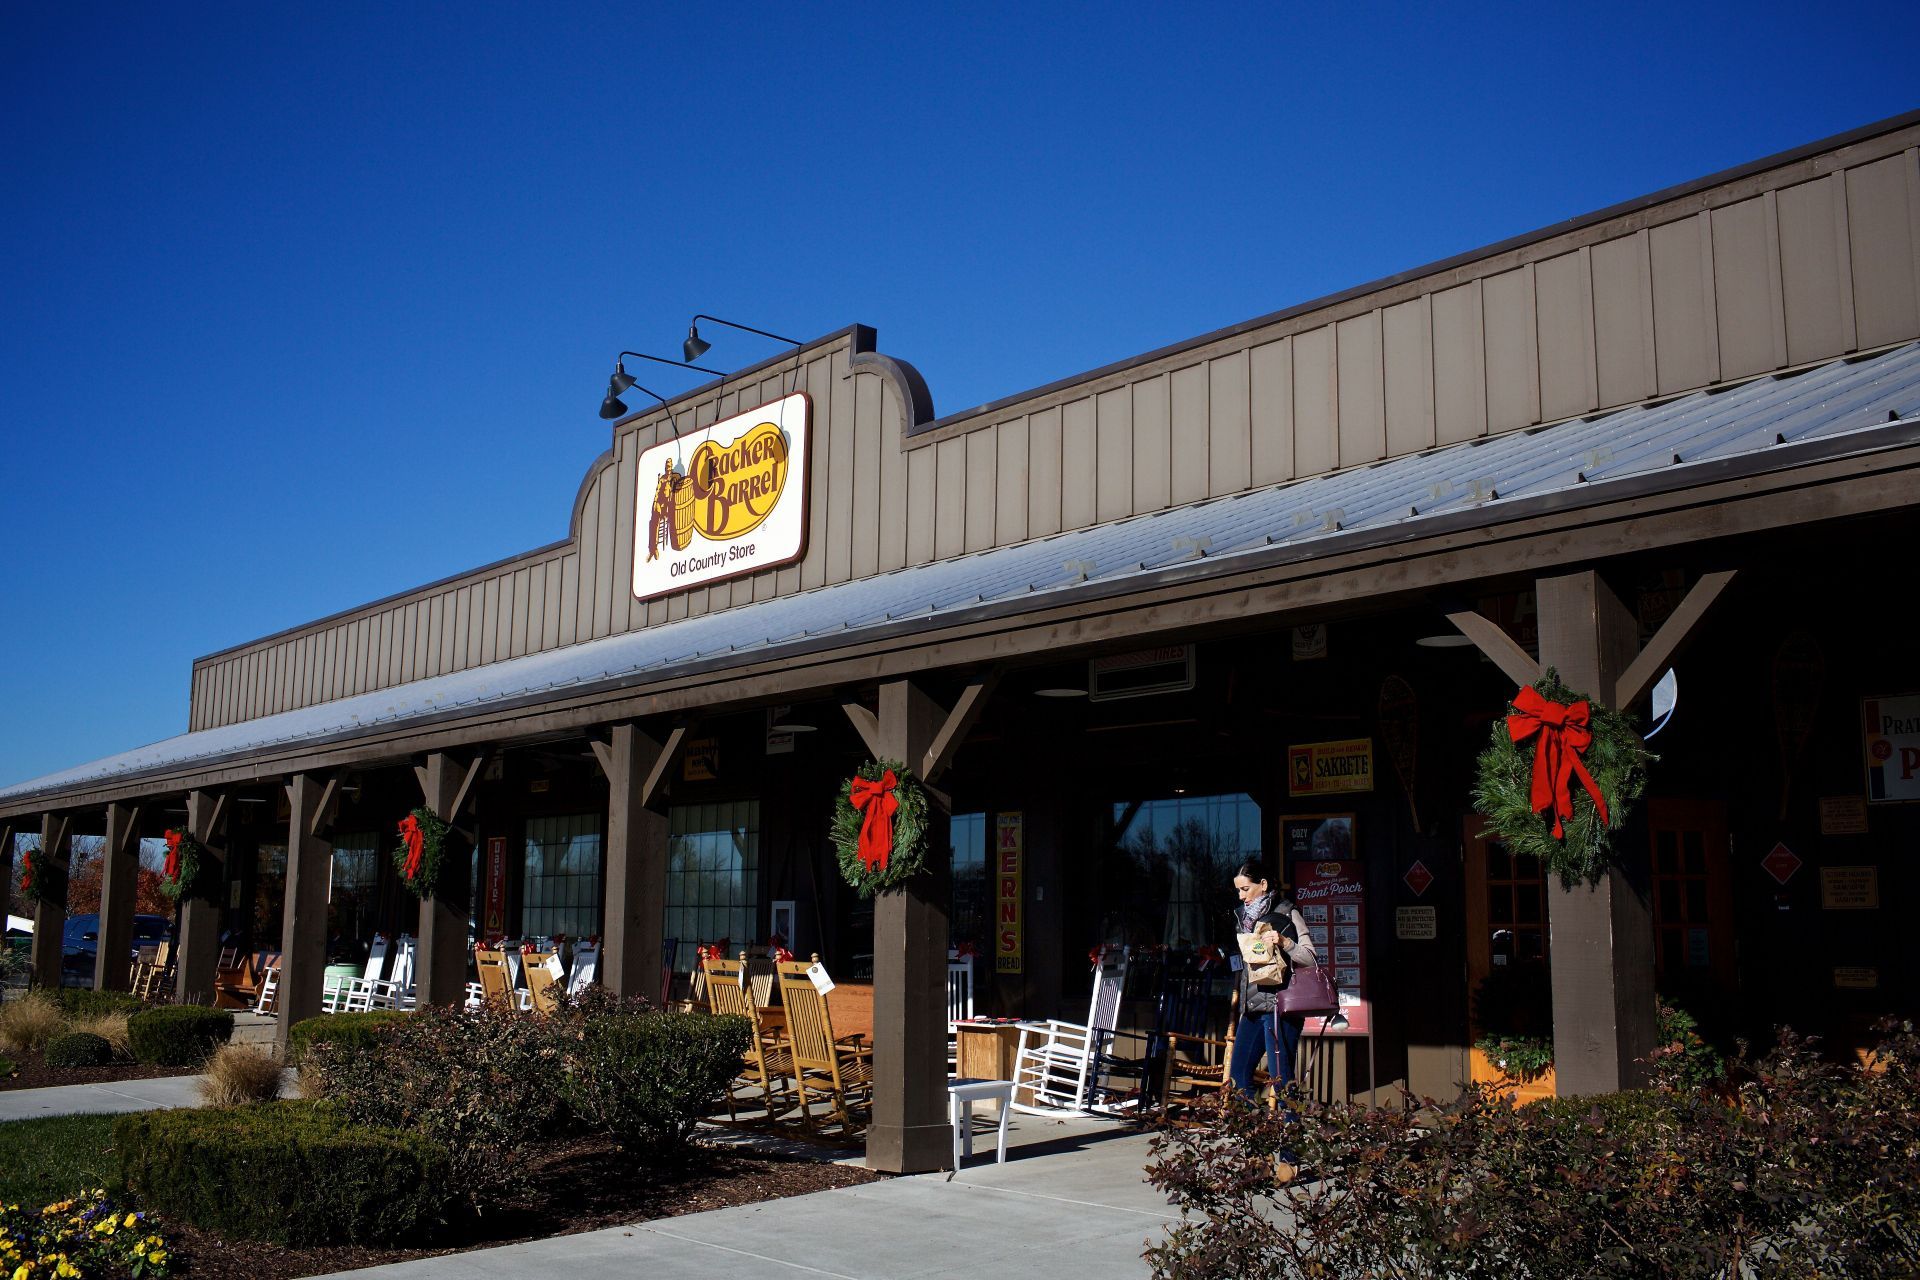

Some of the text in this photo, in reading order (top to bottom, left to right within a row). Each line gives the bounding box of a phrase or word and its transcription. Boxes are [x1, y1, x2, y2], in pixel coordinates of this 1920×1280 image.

[688, 434, 776, 500] Cracker
[706, 463, 778, 536] Barrel
[670, 543, 755, 577] Old Country Store
[1315, 754, 1369, 778] SAKRETE
[1292, 828, 1308, 839] COZY
[1000, 827, 1017, 952] KERN'S
[1297, 886, 1329, 900] Front
[1330, 881, 1363, 896] Porch
[997, 956, 1020, 969] BREAD
